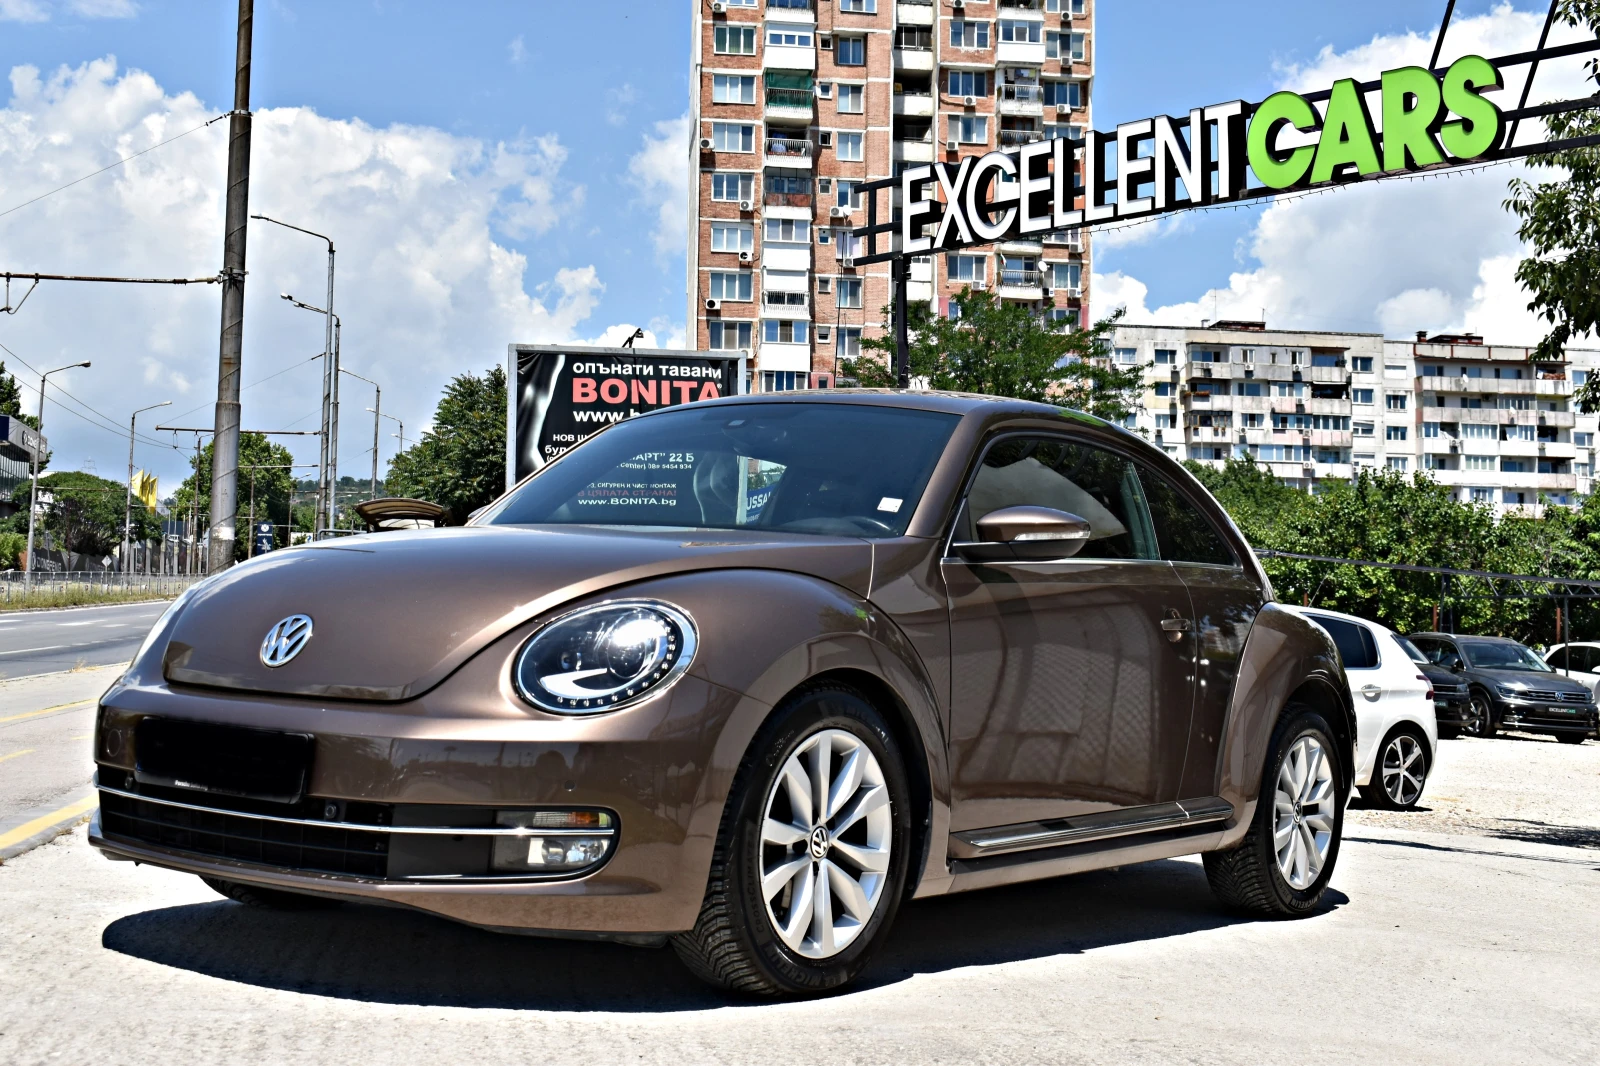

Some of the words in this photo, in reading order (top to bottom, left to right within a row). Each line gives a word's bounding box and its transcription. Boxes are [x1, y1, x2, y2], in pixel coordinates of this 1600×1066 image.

[573, 362, 654, 376] опънати
[659, 364, 722, 379] тавани
[572, 377, 721, 405] BONITA
[552, 433, 575, 442] нов
[668, 452, 683, 463] 22
[578, 497, 677, 507] www.BONITA.bg
